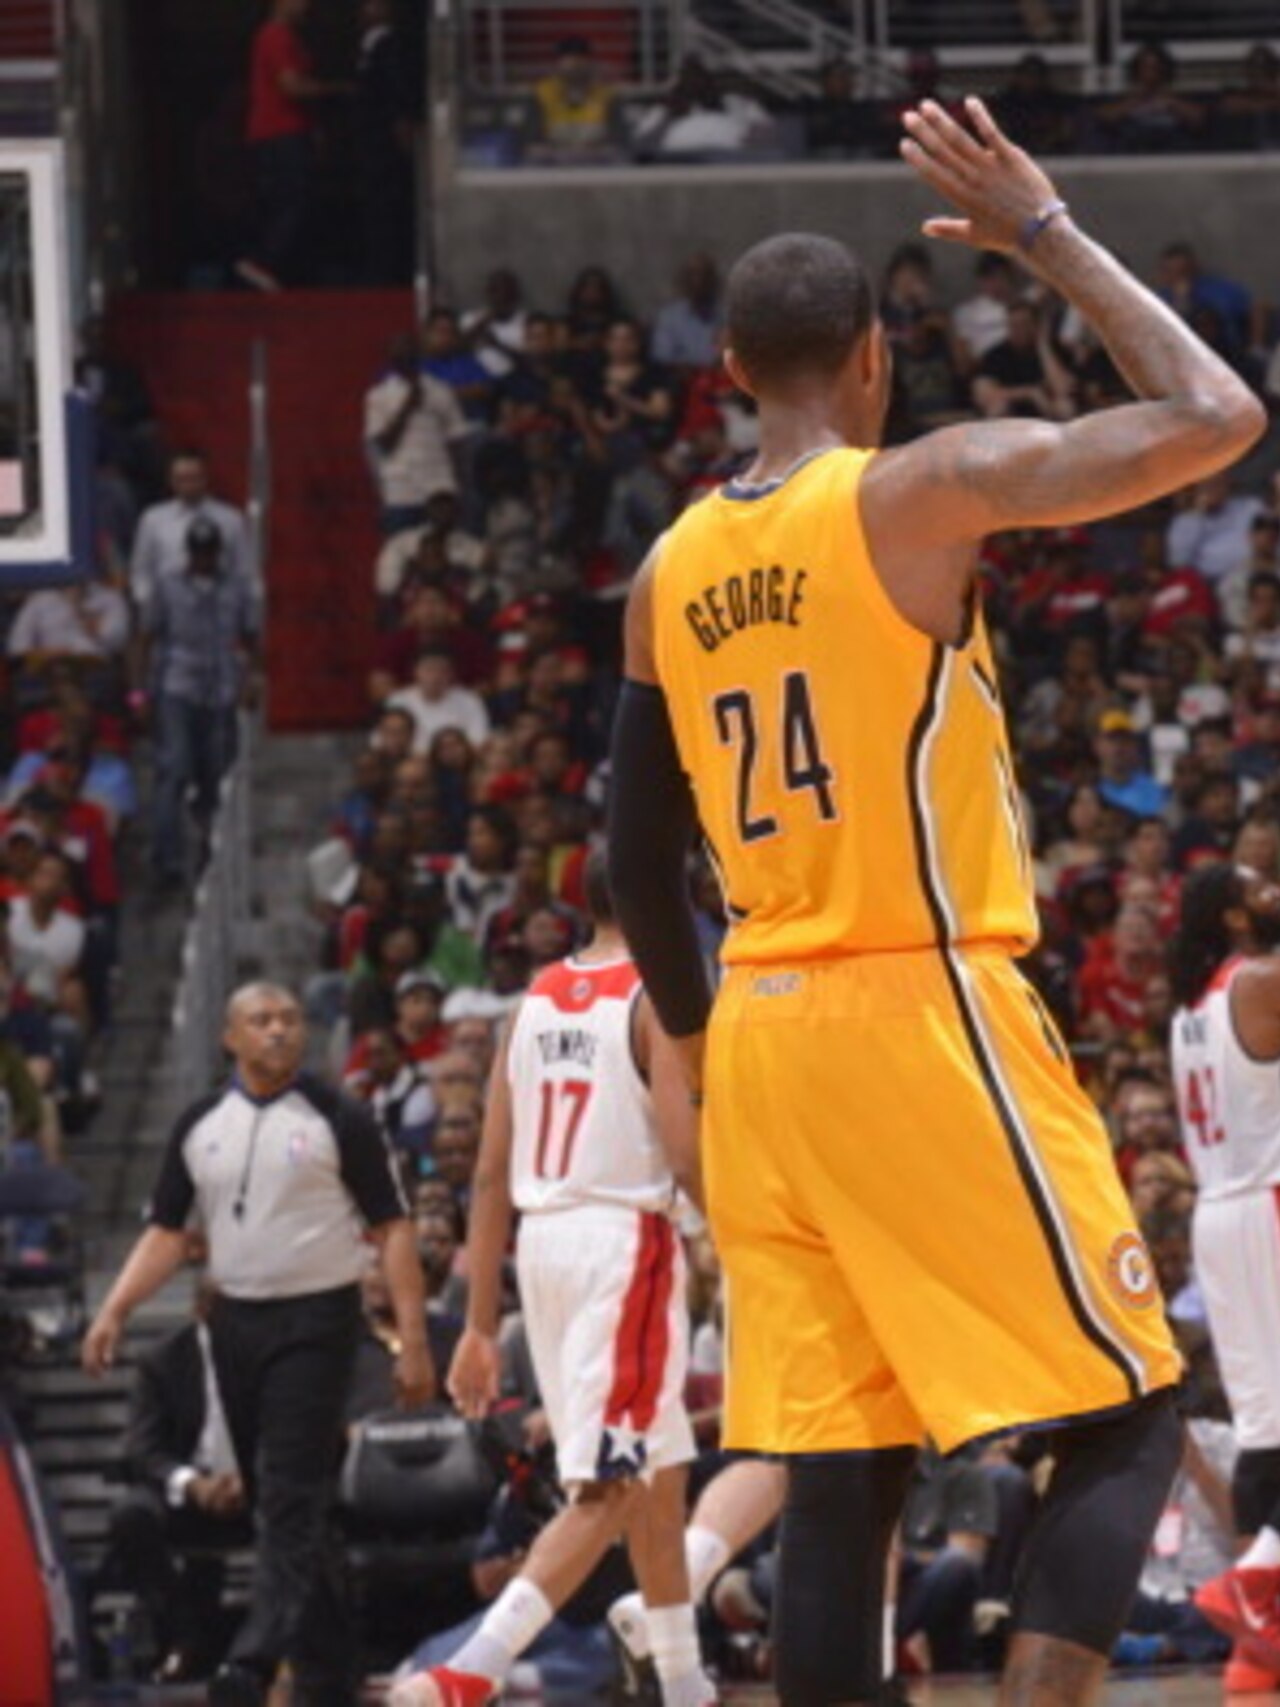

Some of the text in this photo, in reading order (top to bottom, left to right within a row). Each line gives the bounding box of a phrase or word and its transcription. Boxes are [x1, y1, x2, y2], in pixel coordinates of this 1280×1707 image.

[684, 563, 807, 654] GEORGE
[712, 670, 836, 844] 24
[534, 1077, 592, 1181] 17
